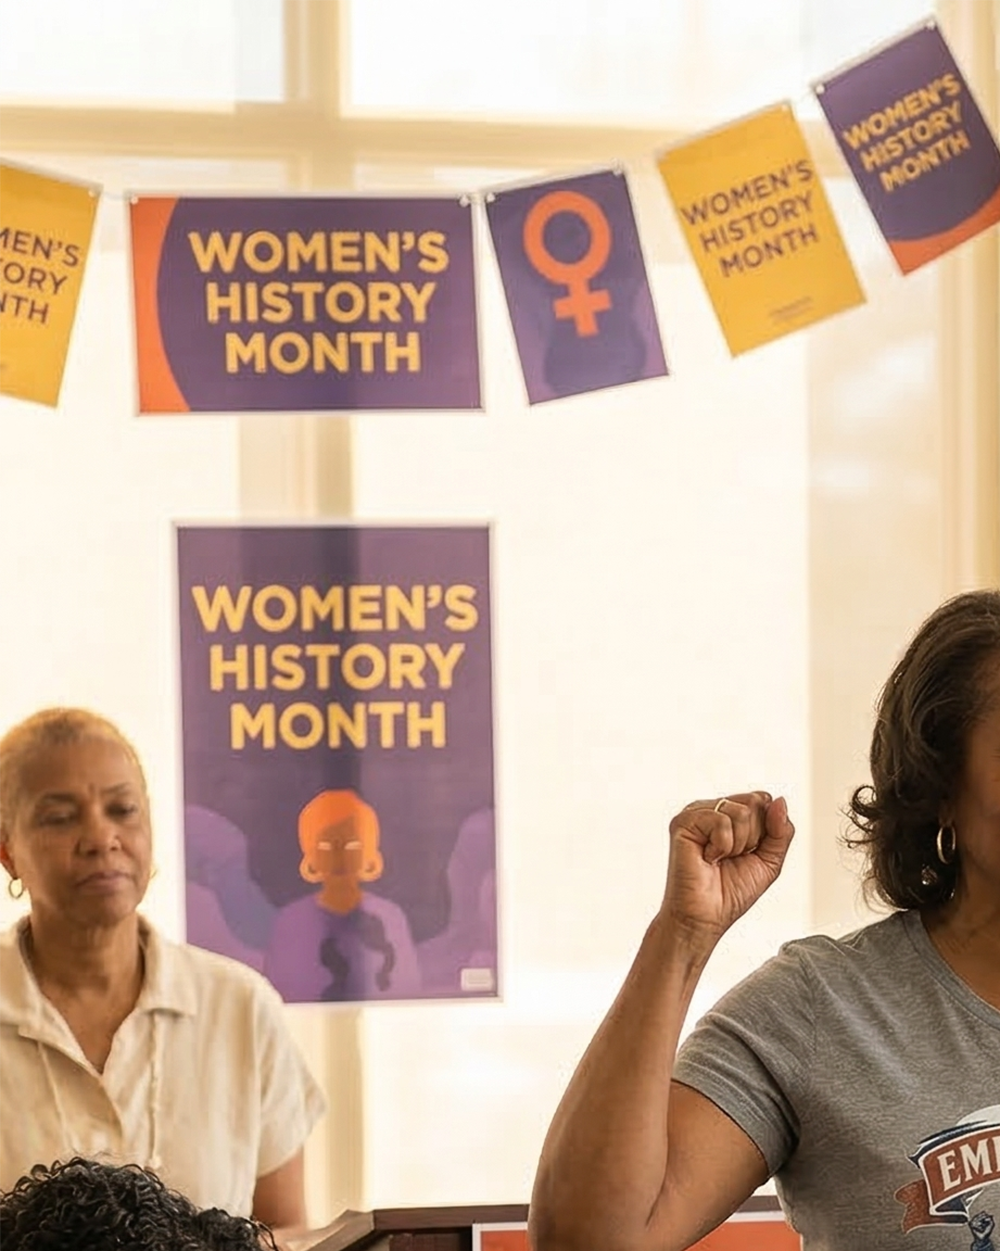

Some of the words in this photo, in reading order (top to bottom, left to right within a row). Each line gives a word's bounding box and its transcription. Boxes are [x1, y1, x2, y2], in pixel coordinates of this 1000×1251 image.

[843, 74, 961, 150] WOMEN'S
[860, 101, 962, 173] HISTORY
[880, 130, 971, 191] MONTH
[680, 159, 814, 226] WOMEN'S
[698, 190, 813, 253] HISTORY
[189, 230, 449, 273] WOMEN'S
[719, 223, 819, 278] MONTH
[206, 281, 435, 323] HISTORY
[225, 331, 421, 374] MONTH
[191, 584, 478, 632] WOMEN'S
[209, 642, 464, 691] HISTORY
[230, 701, 446, 750] MONTH
